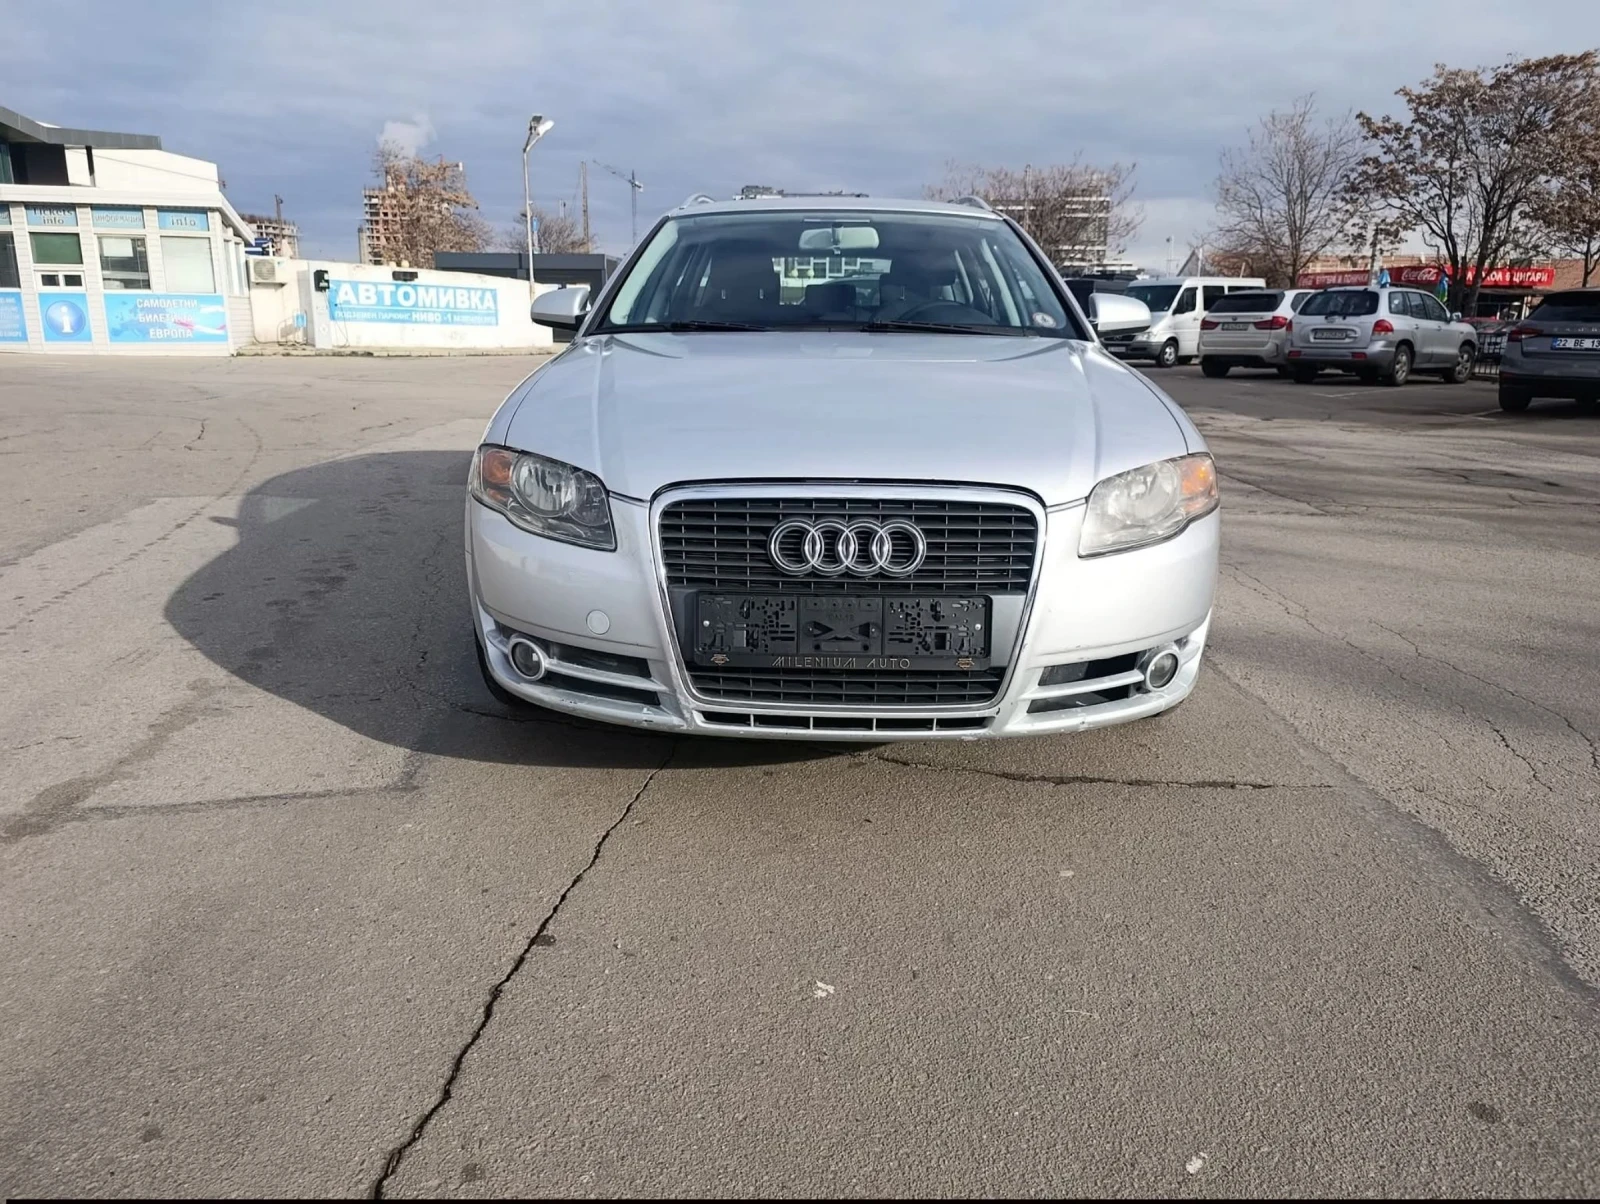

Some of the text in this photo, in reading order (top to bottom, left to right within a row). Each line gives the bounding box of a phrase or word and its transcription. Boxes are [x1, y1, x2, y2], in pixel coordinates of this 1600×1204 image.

[171, 216, 196, 226] info
[1513, 271, 1548, 283] ЦИГАРИ
[337, 283, 495, 309] АВТОМИВКА
[137, 298, 197, 308] САМОЛЕТНИ
[412, 312, 441, 322] НИВО
[149, 327, 194, 339] ЕВРОПА
[1557, 338, 1568, 347] 22
[1574, 339, 1585, 347] BE
[772, 656, 911, 669] MILENIUM AUTO
